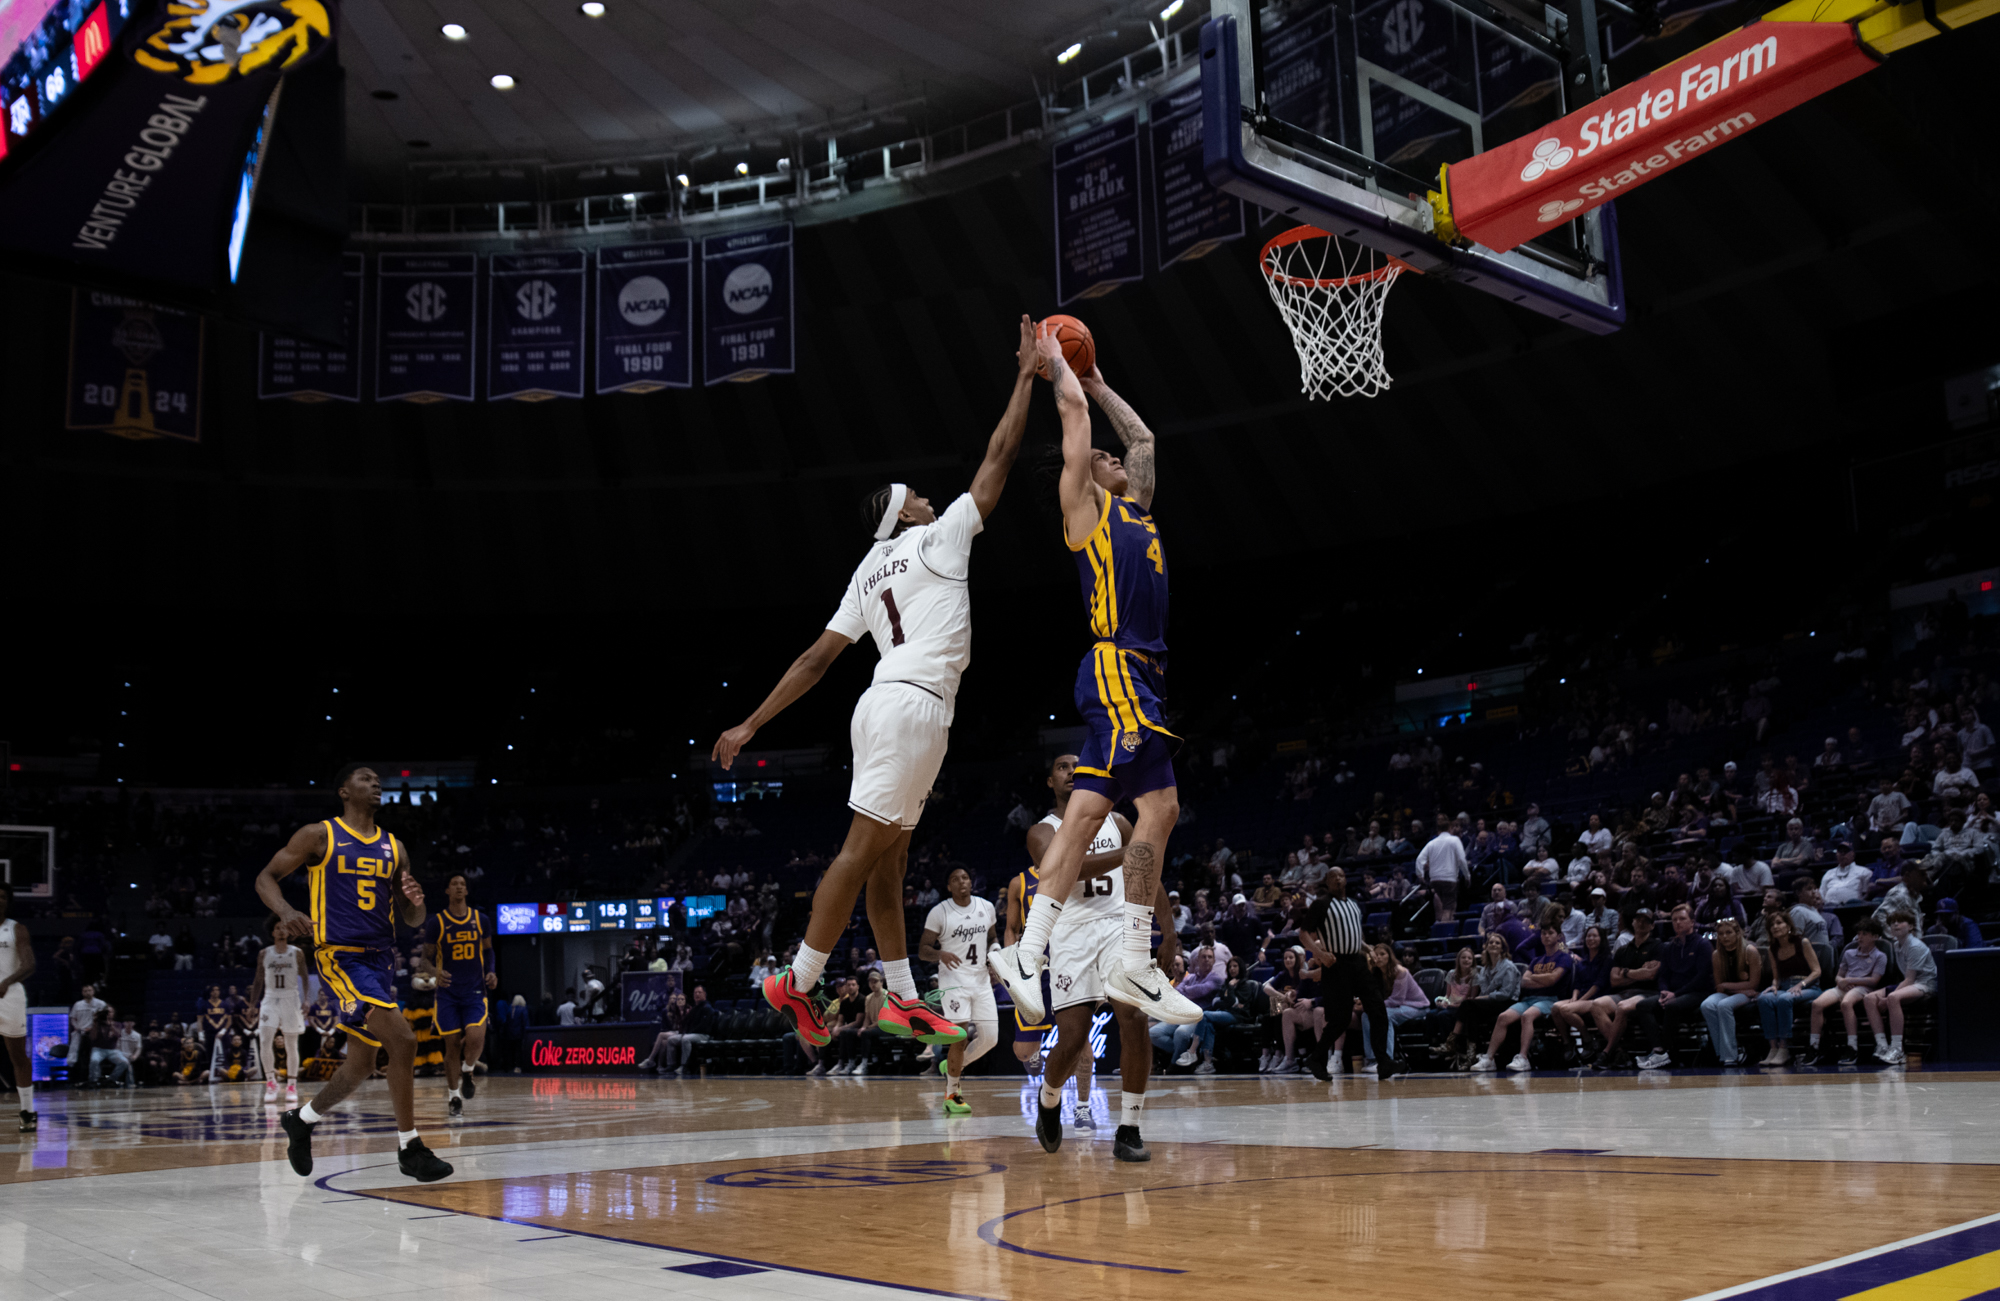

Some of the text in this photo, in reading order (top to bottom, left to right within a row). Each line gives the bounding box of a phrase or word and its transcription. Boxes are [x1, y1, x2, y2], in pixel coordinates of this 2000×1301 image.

[72, 168, 152, 250] VENTURE
[124, 93, 209, 172] GLOBAL
[1069, 176, 1125, 211] BREAUX
[405, 281, 447, 322] SEC
[515, 279, 557, 320] SEC
[729, 284, 770, 303] NCAA
[624, 298, 669, 313] NCAA
[511, 325, 561, 336] CHAMPIONS
[720, 327, 776, 346] FINAL FOUR
[614, 341, 672, 355] FINAL FOUR
[730, 342, 765, 363] 1991
[623, 355, 664, 373] 1990
[83, 382, 188, 413] 20 24
[1118, 505, 1157, 534] LS
[1146, 538, 1164, 575] 4
[863, 558, 909, 596] PHELPS
[880, 587, 905, 648] 1
[337, 855, 393, 878] LSU
[357, 879, 376, 911] 5
[1083, 875, 1113, 898] 15
[599, 903, 628, 917] 15.8
[639, 905, 652, 916] 10
[542, 916, 563, 932] 66
[618, 919, 625, 929] 2
[951, 923, 987, 942] Aggies
[446, 930, 478, 943] LSU
[452, 943, 475, 960] 20
[965, 944, 978, 965] 4
[275, 974, 285, 988] 11
[531, 1039, 636, 1066] Coke ZERO SUGAR
